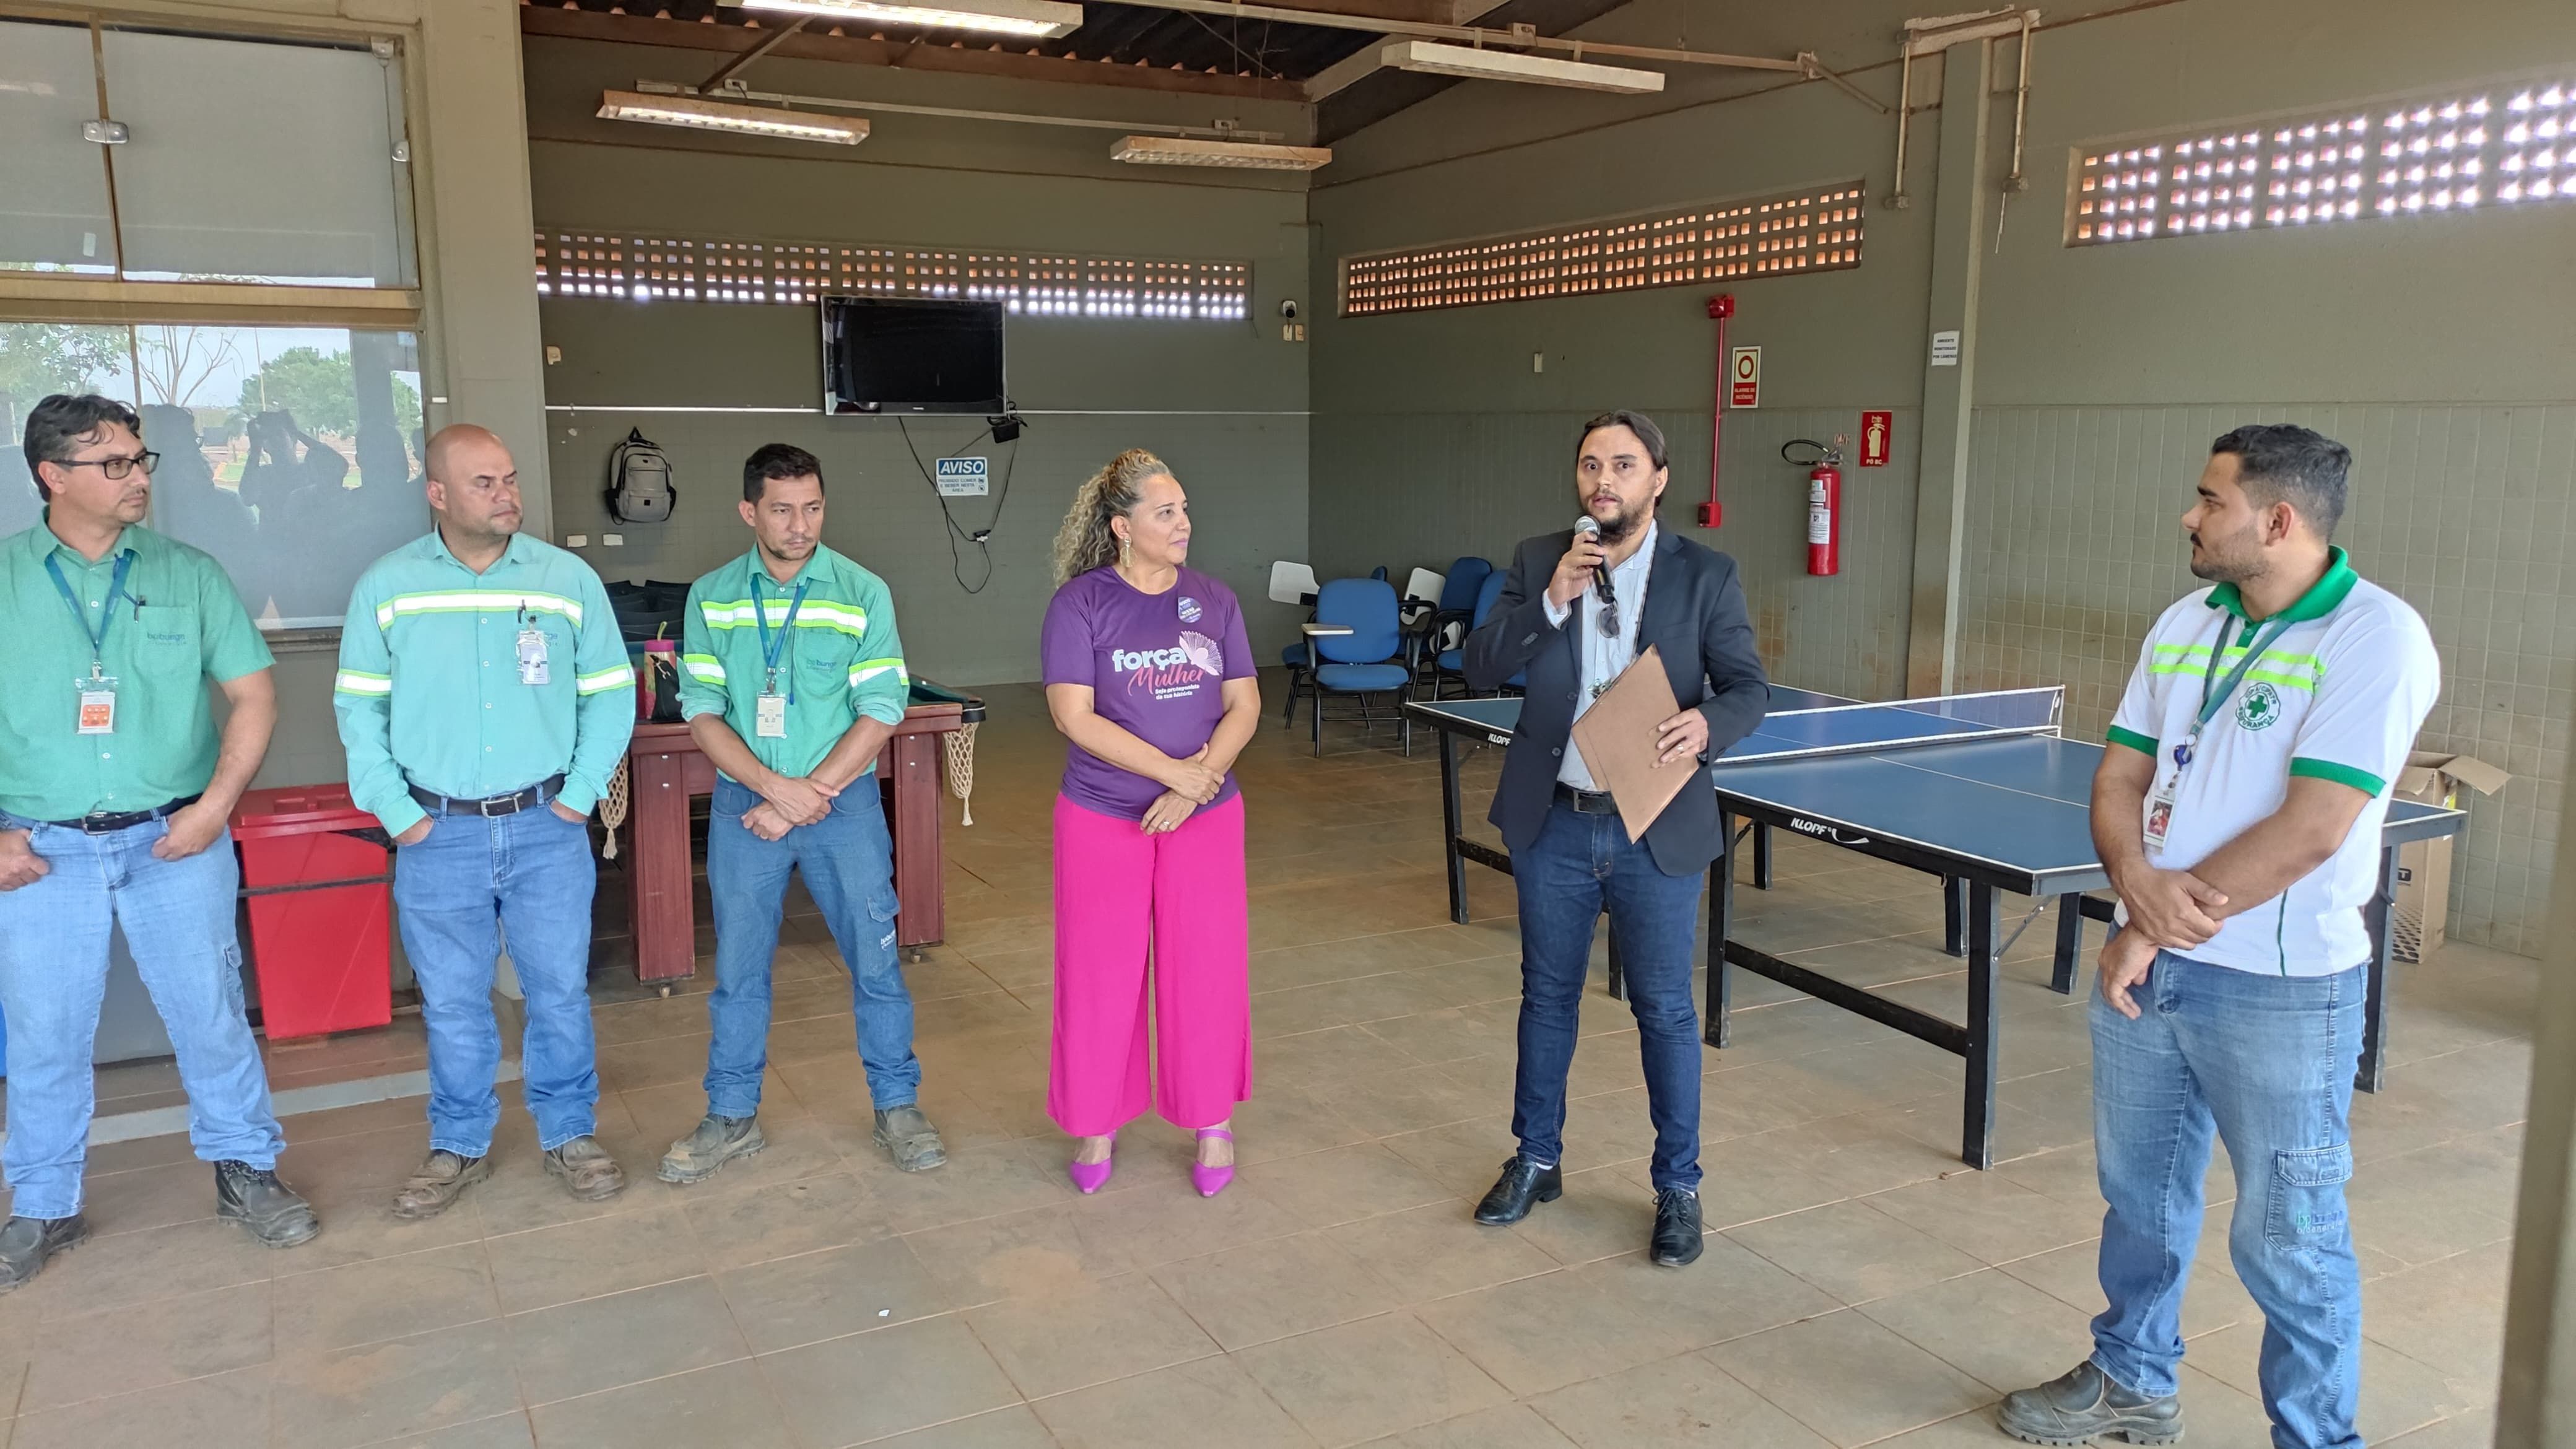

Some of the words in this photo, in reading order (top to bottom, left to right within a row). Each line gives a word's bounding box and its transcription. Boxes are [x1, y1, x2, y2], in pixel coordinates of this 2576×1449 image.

[940, 461, 984, 474] AVISO
[1112, 647, 1188, 672] força
[1128, 664, 1204, 696] Mulher
[1167, 684, 1200, 694] protagonista
[1487, 733, 1511, 746] KLOPF
[1791, 817, 1827, 835] KLOPF
